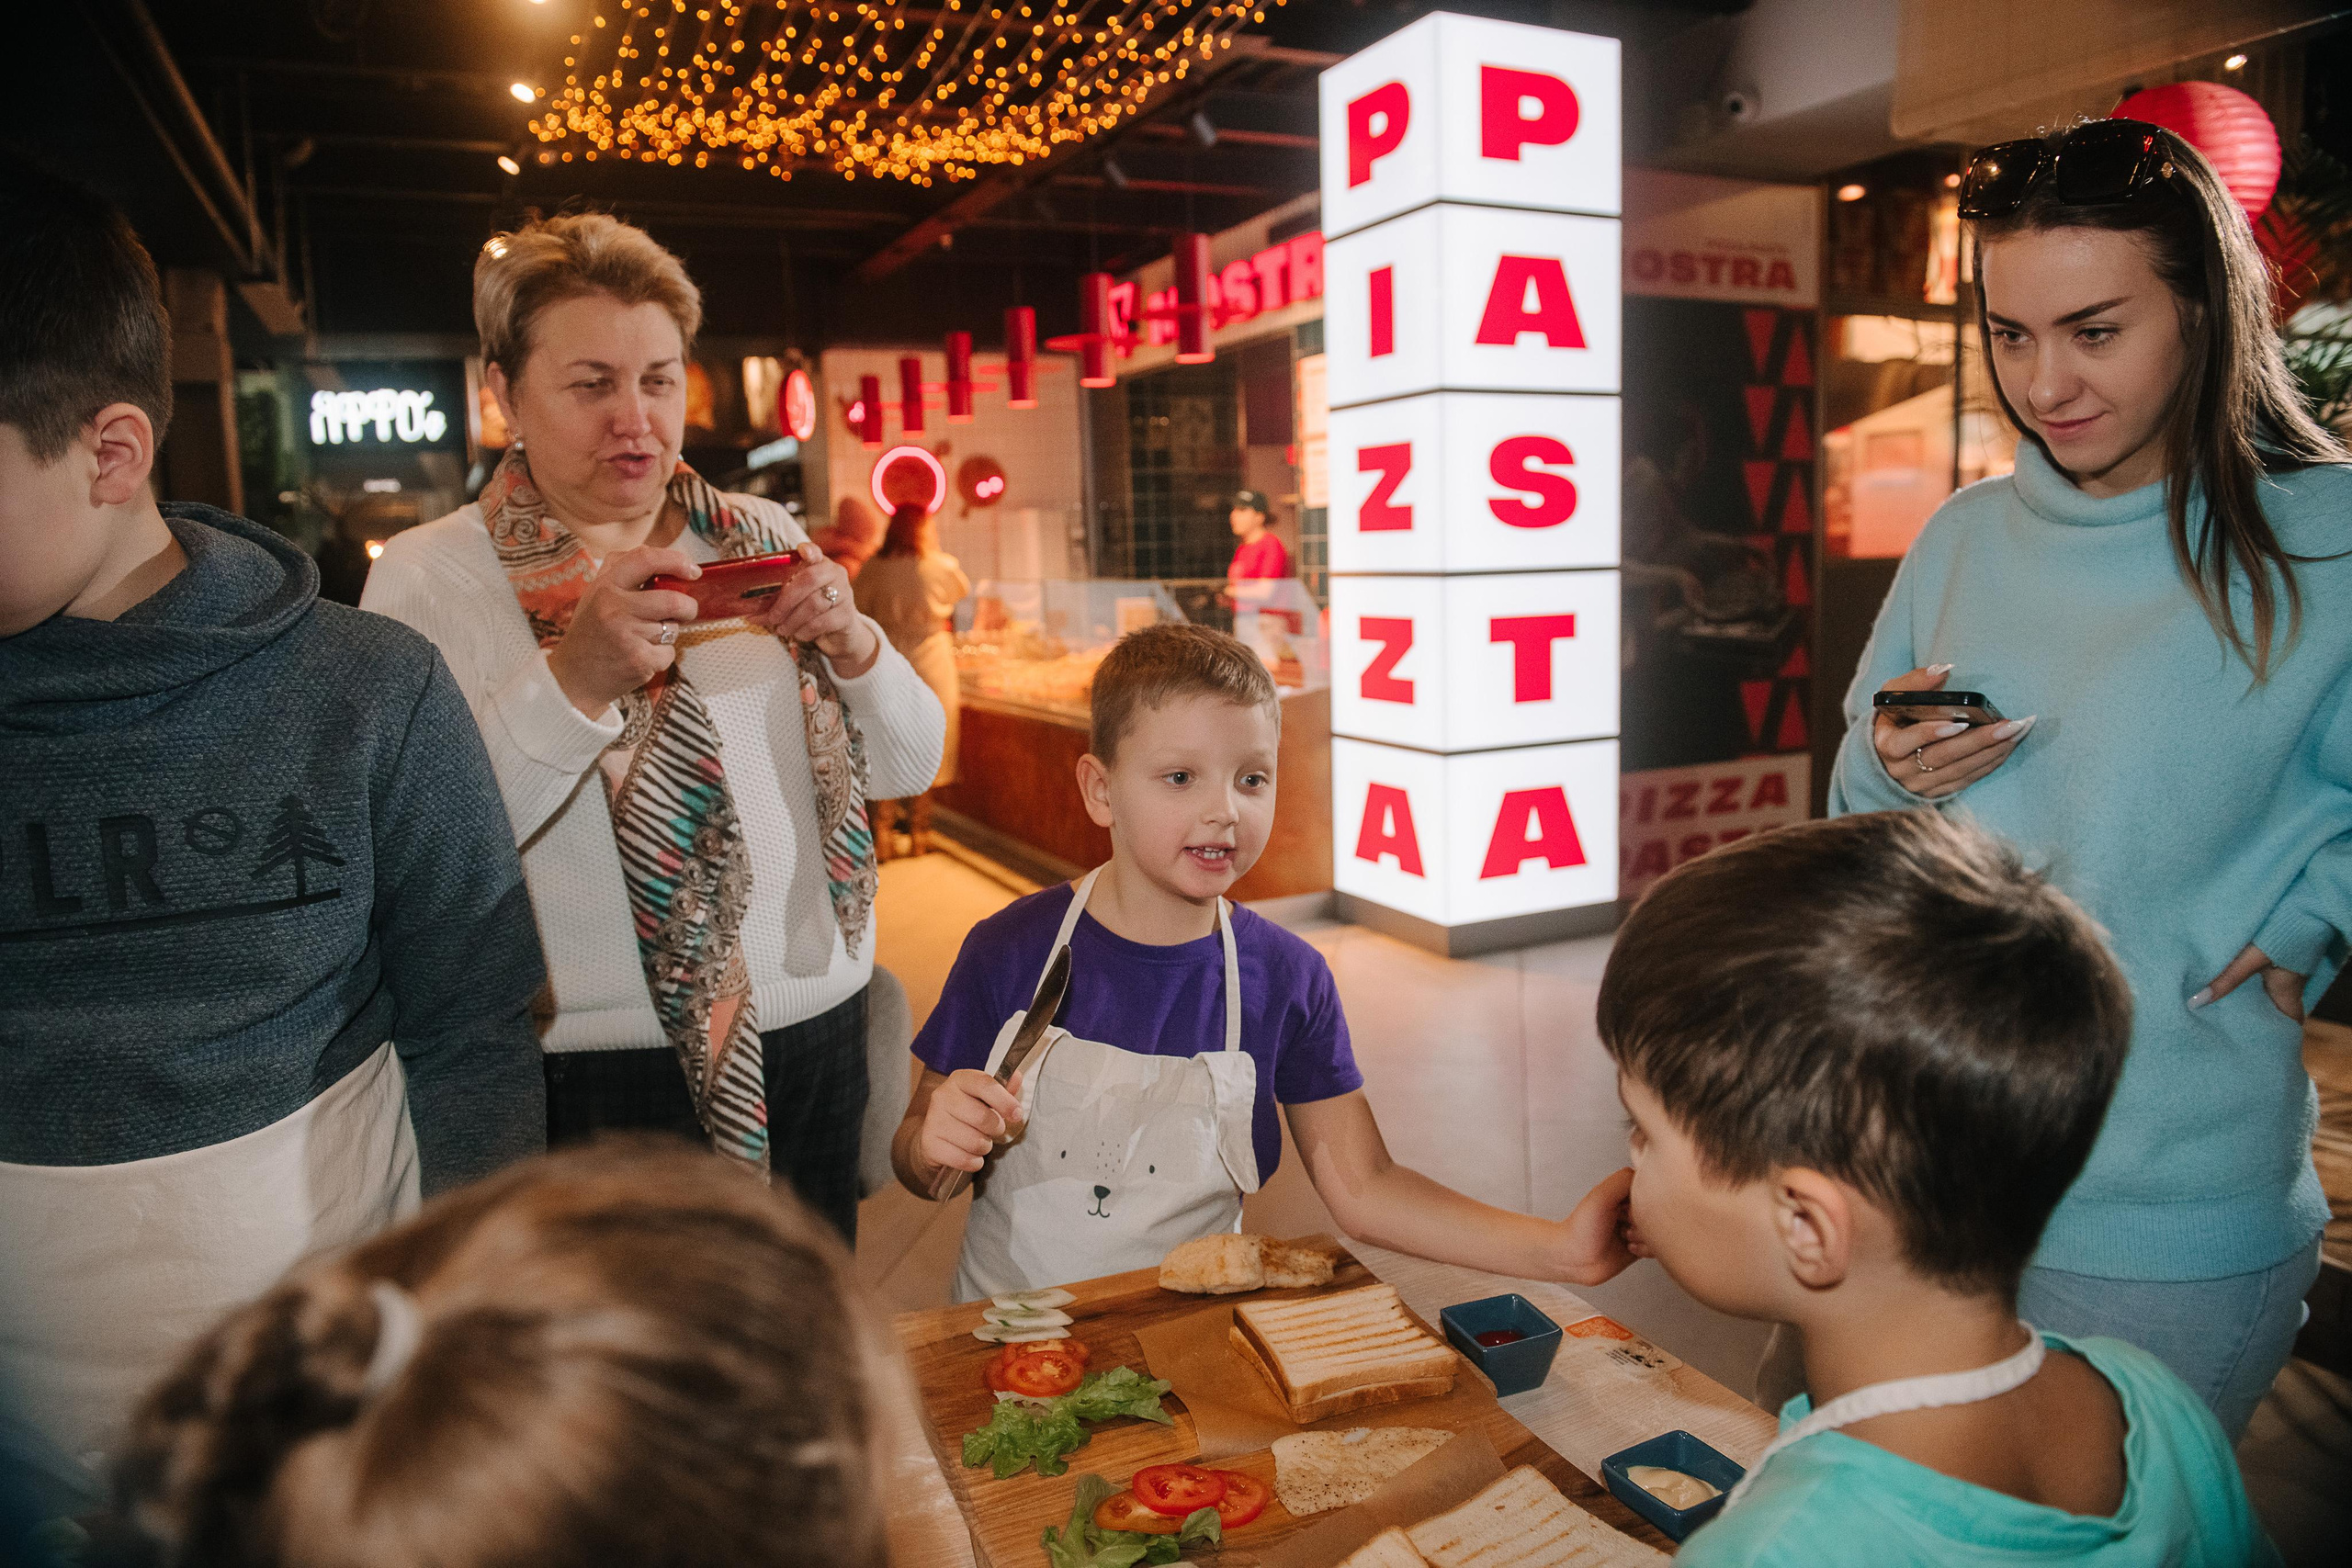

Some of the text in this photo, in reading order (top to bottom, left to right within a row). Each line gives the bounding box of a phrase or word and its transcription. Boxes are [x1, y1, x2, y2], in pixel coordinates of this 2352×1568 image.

[1632, 249, 1796, 290] OSTRA
[1347, 81, 1425, 878] PIZZA
[1476, 63, 1588, 879] PASTA
[1621, 773, 1789, 824] IZZA
[0, 813, 165, 916] LR
